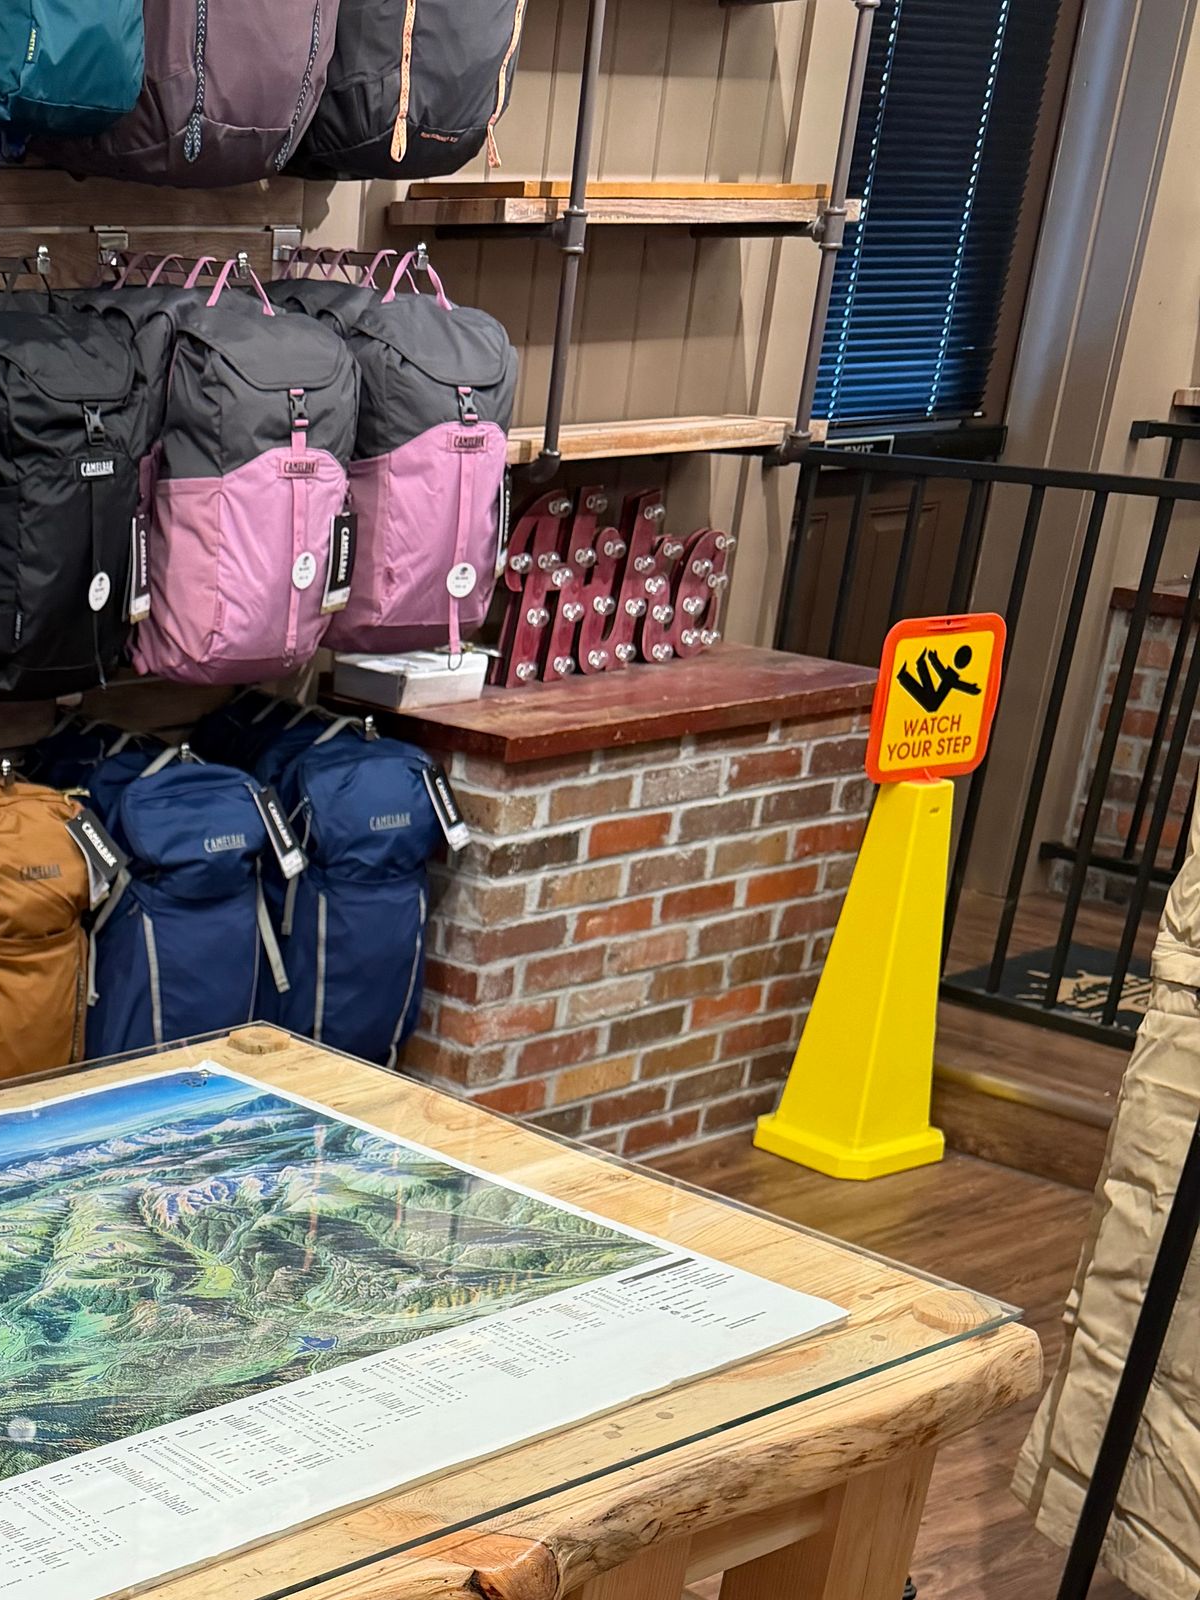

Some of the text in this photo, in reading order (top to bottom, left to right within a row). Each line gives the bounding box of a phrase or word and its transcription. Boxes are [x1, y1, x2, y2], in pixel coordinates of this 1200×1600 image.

[904, 714, 962, 738] WATCH
[888, 736, 972, 761] YOUR STEP
[369, 812, 411, 831] CAMELBAK
[204, 833, 247, 853] CAMELBAK
